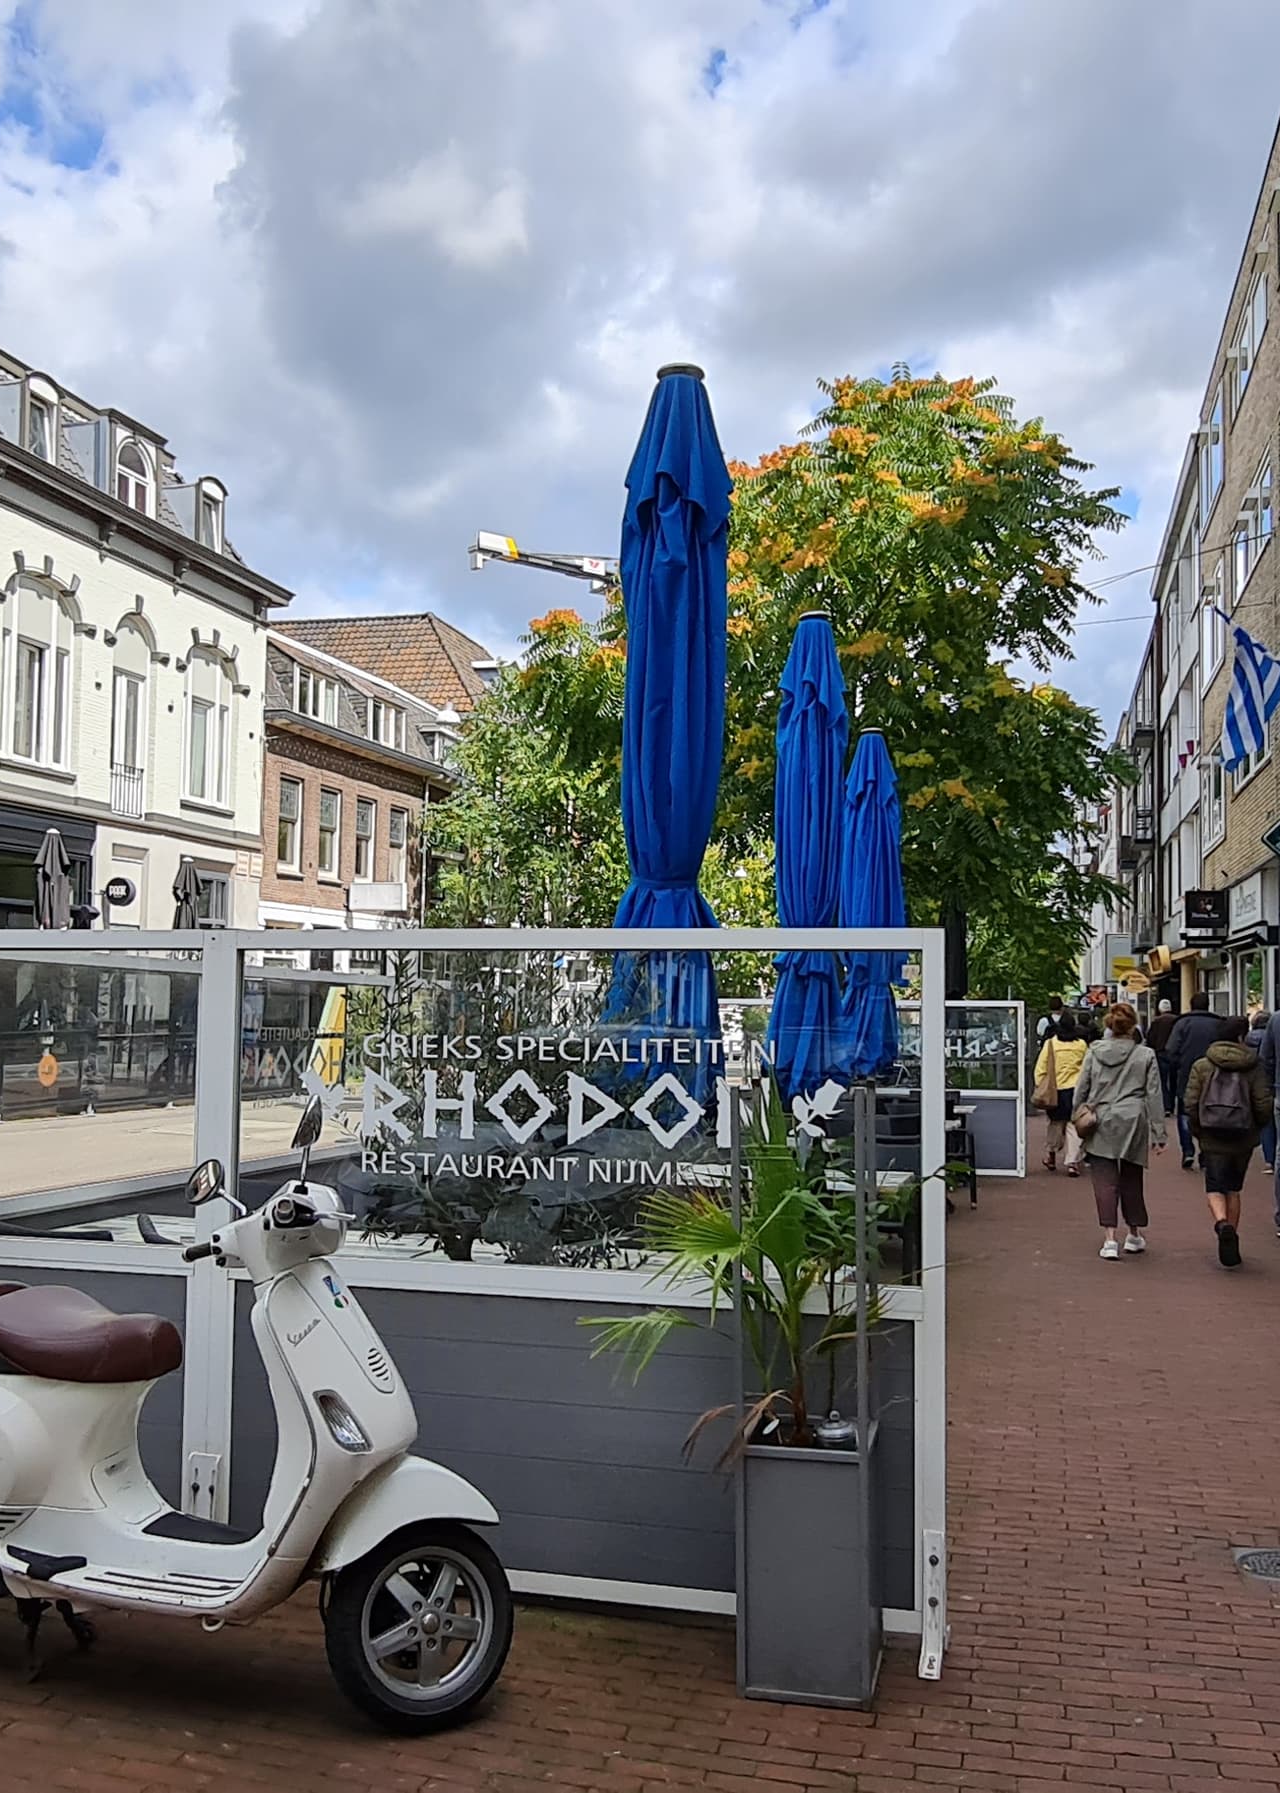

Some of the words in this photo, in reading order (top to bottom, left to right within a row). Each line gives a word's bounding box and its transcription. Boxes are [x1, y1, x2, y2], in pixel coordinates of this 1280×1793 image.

[363, 1034, 483, 1060] GRIEKS
[496, 1036, 776, 1065] SPECIALITEITEN
[361, 1151, 580, 1182] RESTAURANT
